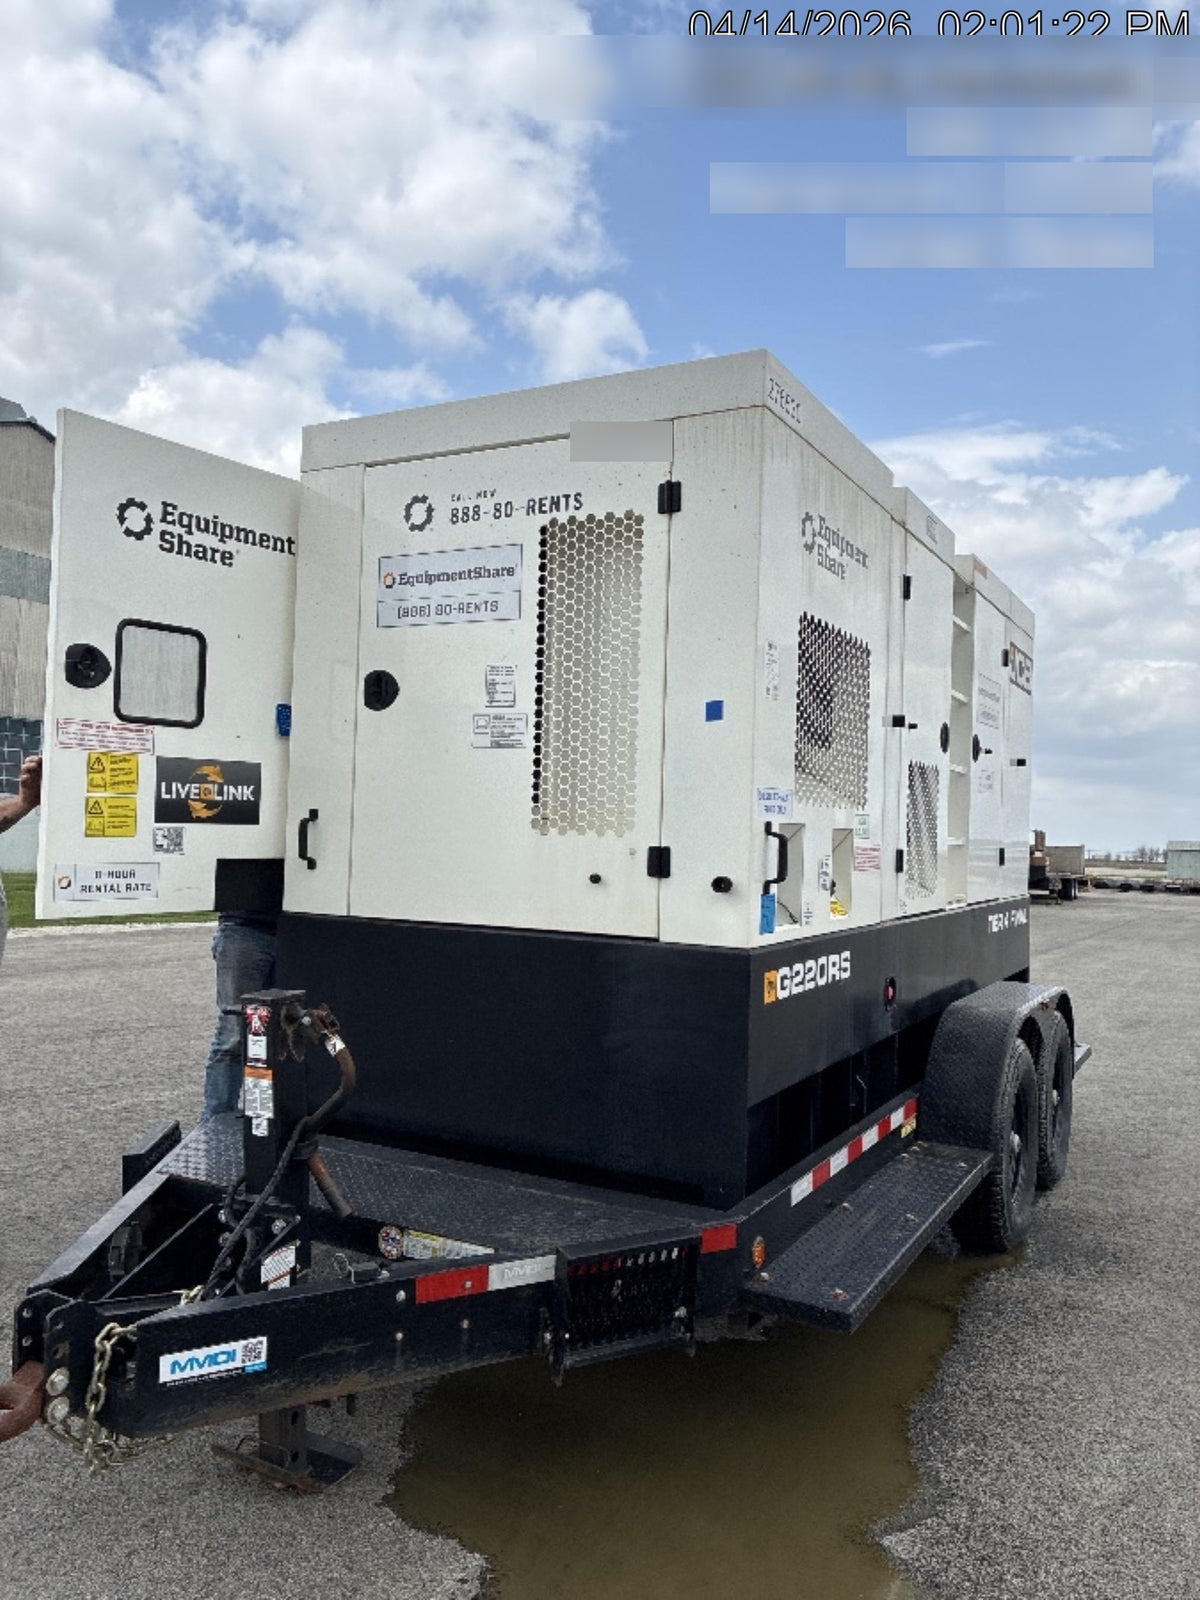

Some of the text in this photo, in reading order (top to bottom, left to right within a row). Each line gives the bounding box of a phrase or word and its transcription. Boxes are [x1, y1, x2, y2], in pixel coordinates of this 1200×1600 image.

[450, 491, 583, 525] 888-80-RENTS
[159, 500, 296, 557] Equipment
[158, 529, 234, 568] Share
[397, 565, 517, 588] EquipmentShare
[161, 781, 255, 801] LIVE LINK
[80, 882, 152, 894] RENTAL RATE
[776, 950, 851, 1001] G220RS
[170, 1349, 237, 1375] MMDI
